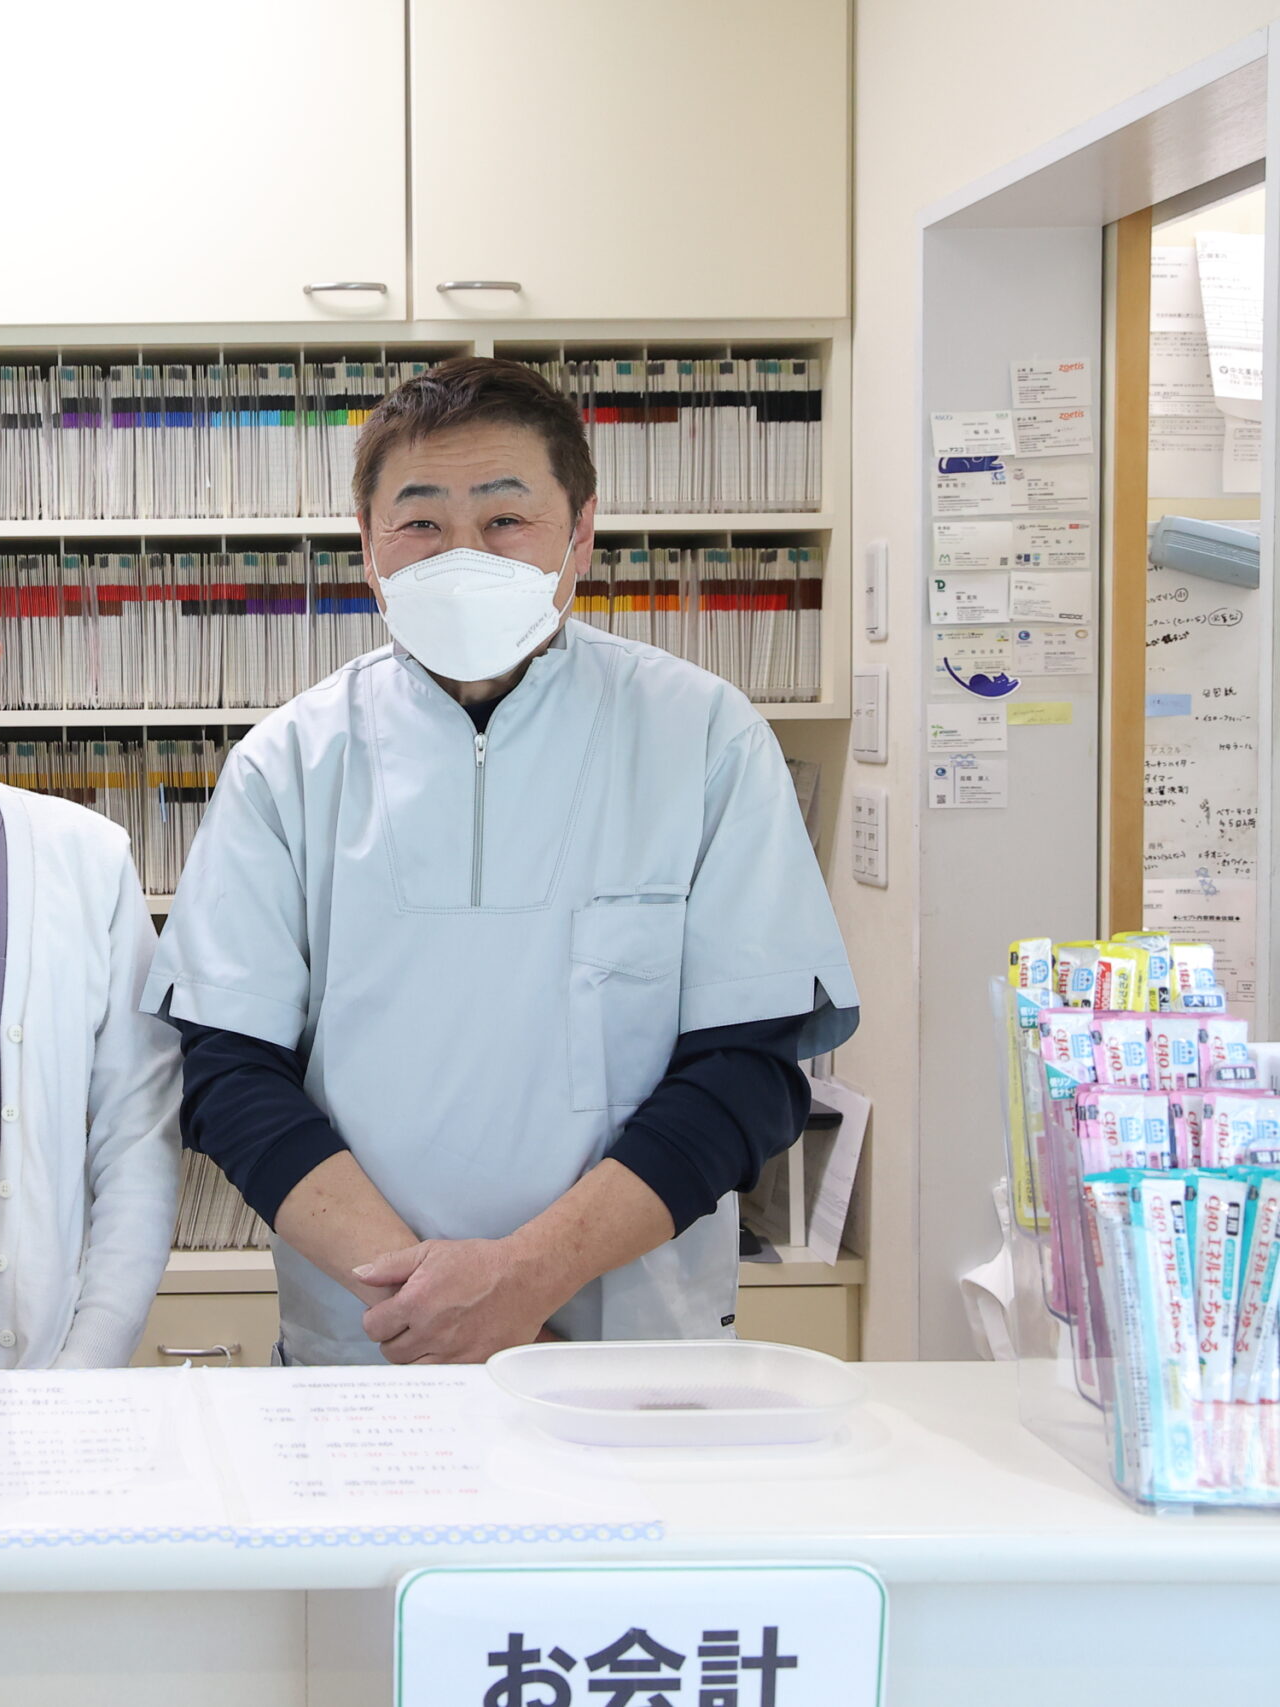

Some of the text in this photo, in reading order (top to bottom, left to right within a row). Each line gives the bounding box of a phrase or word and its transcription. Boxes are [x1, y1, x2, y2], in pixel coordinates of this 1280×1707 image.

[1058, 362, 1085, 373] zoetis
[1058, 410, 1085, 421] zoetis
[1106, 1037, 1123, 1071] CIAO
[1154, 1034, 1169, 1068] CIAO
[1103, 1111, 1118, 1146] CIAO
[1187, 1111, 1200, 1147] CIAO
[1215, 1112, 1230, 1148] CIAO
[1151, 1196, 1166, 1232] CIAO
[1204, 1195, 1220, 1232] CIAO
[1259, 1197, 1277, 1234] CIAO
[483, 1625, 798, 1707] お会計
